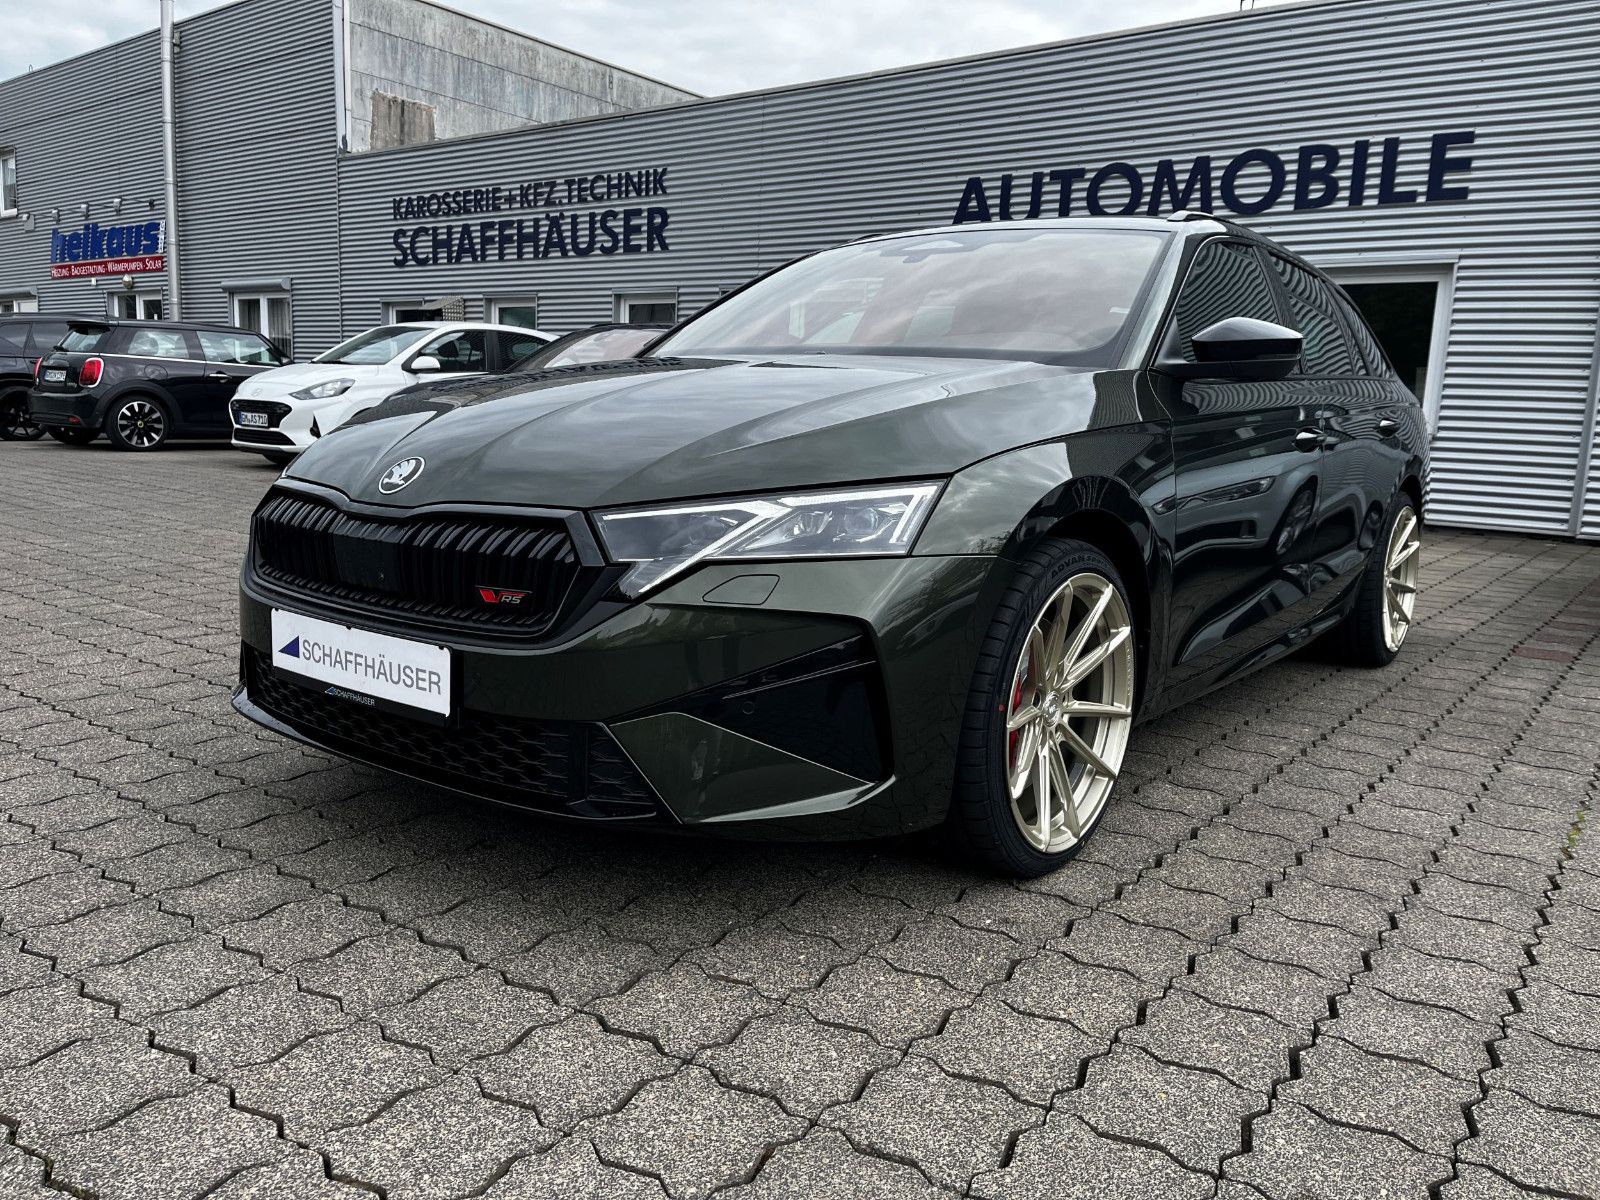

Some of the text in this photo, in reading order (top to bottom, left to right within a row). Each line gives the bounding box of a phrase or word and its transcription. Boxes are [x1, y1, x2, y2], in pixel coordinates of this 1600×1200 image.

[952, 131, 1475, 224] AUTOMOBILE
[51, 223, 158, 263] heikaus
[393, 207, 669, 267] SCHAFFHÄUSER
[302, 638, 442, 695] SCHAFFHÄUSER
[333, 688, 376, 707] SCHAFFHÄUSER
